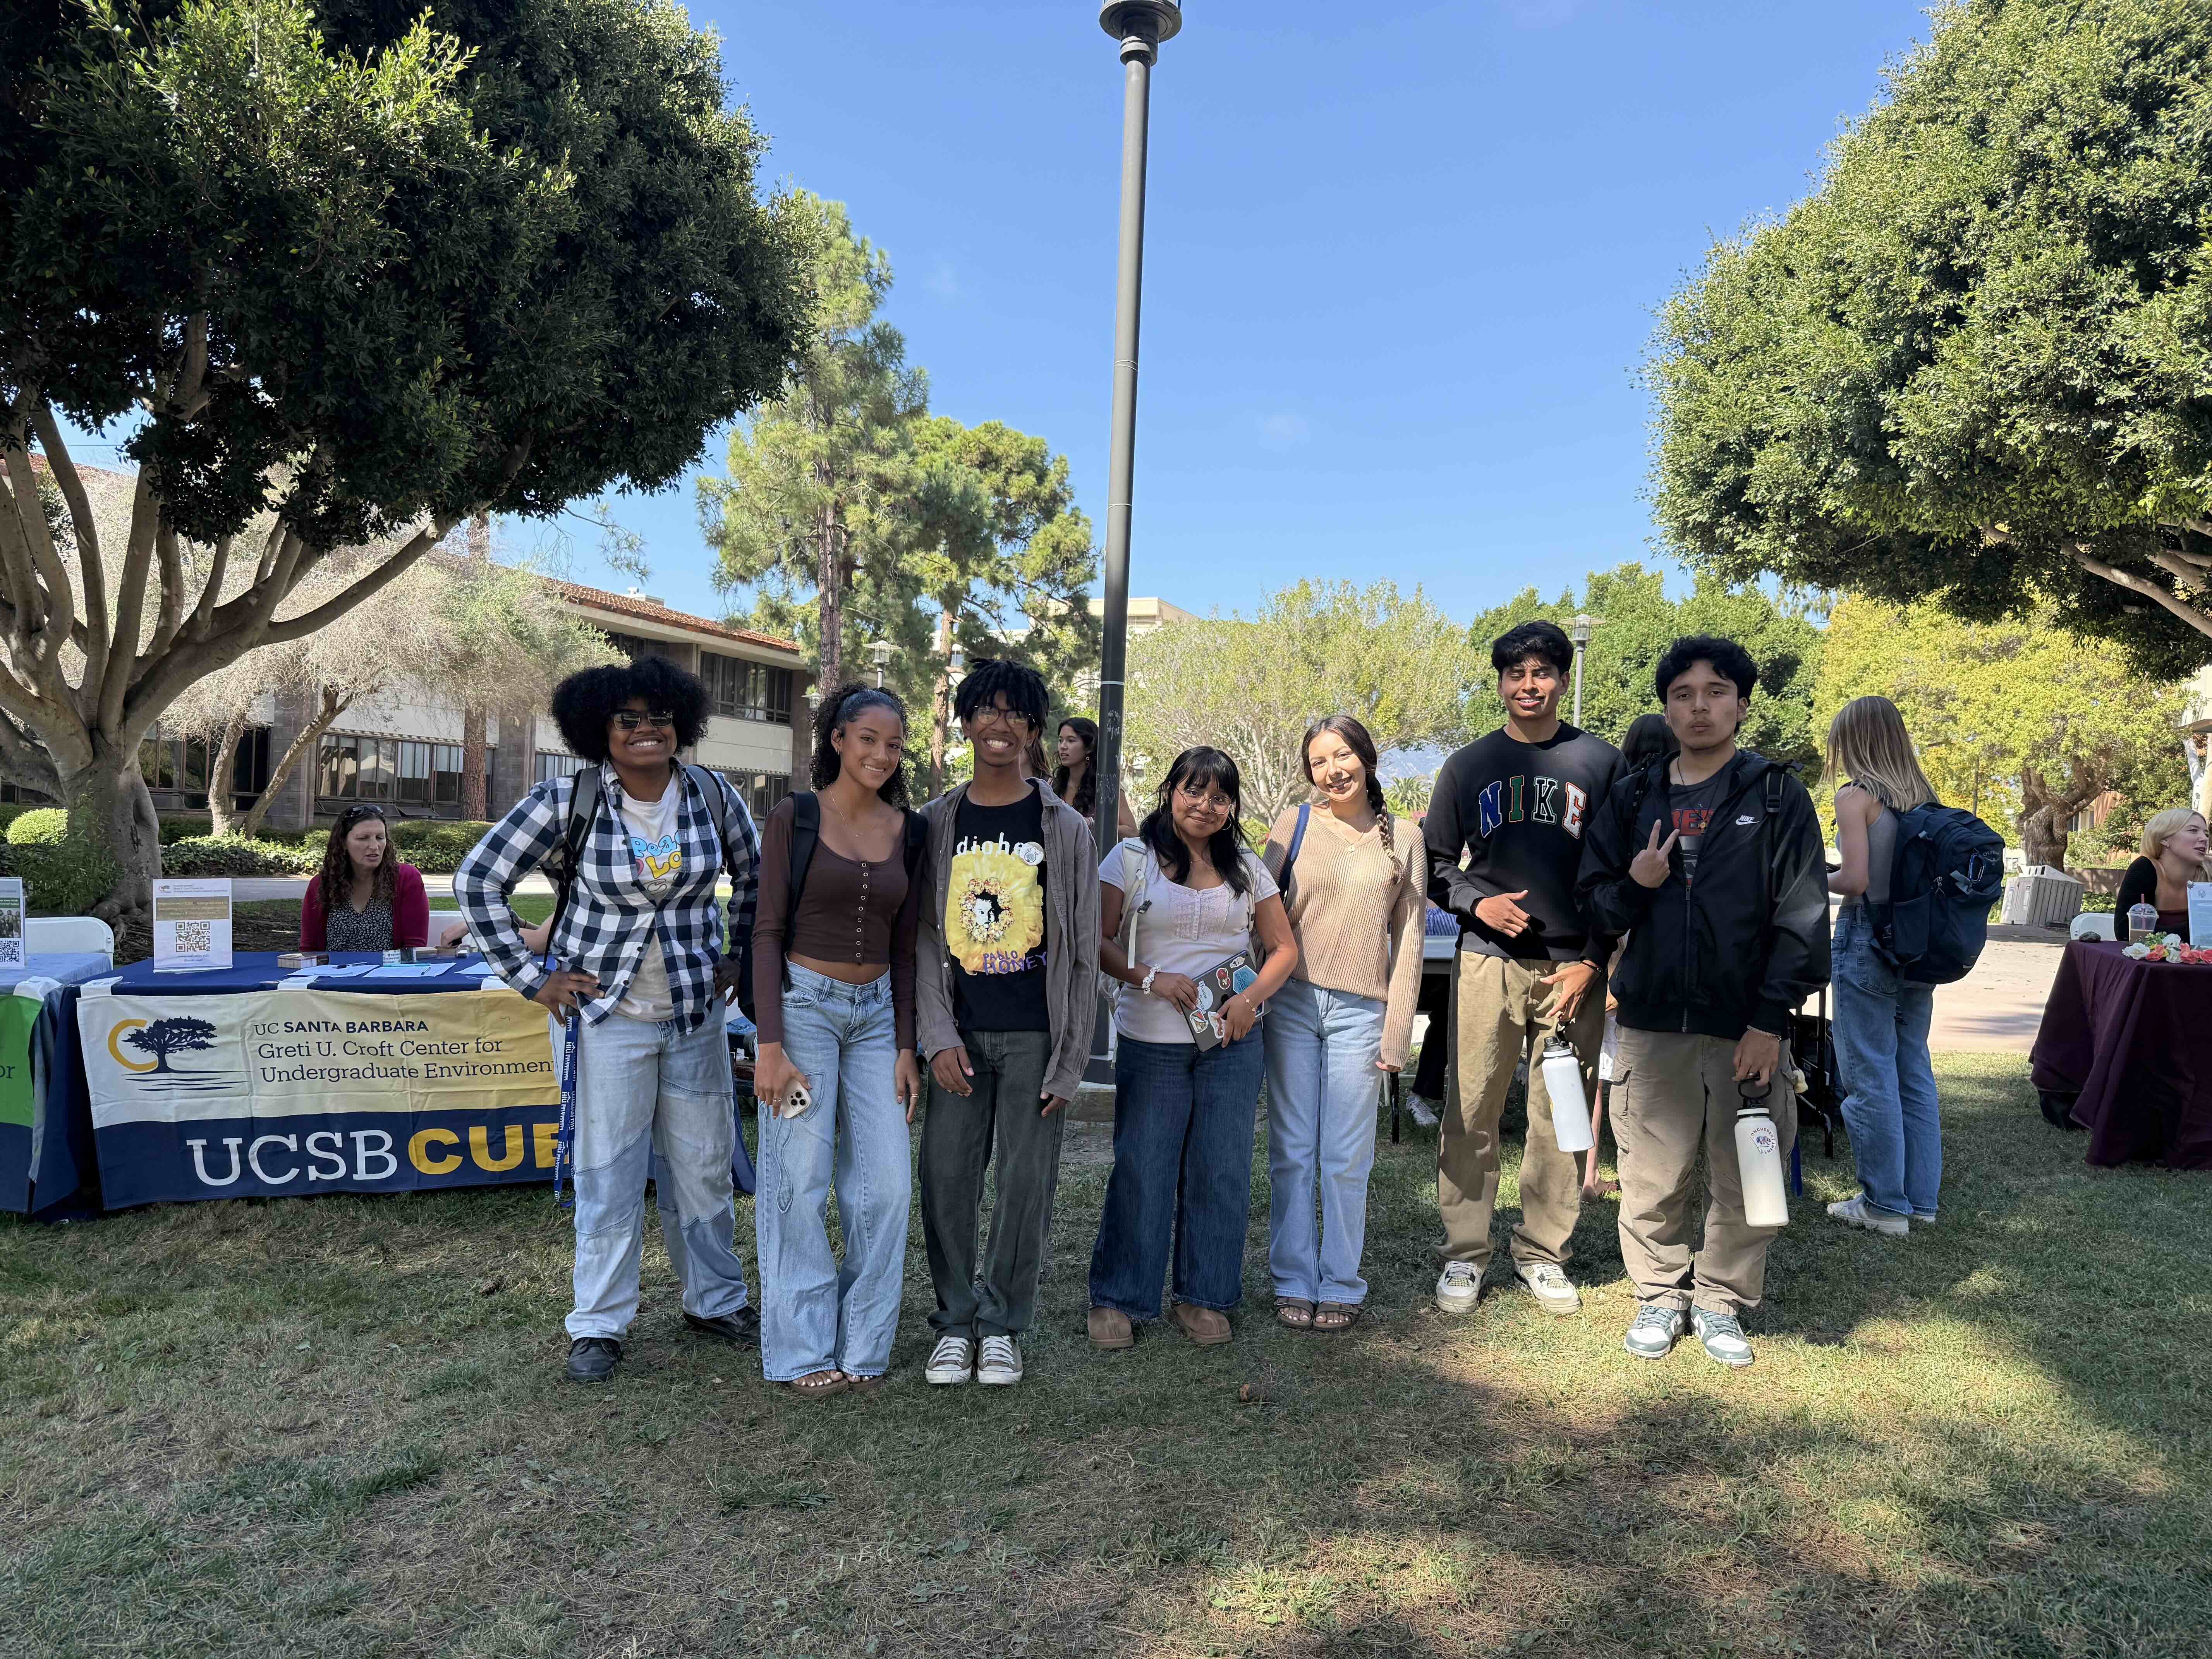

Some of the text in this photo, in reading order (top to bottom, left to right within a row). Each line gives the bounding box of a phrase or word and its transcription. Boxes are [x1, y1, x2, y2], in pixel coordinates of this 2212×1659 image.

[1479, 775, 1587, 839] NIKE
[1738, 815, 1755, 823] NIKE
[983, 950, 1018, 961] PABLO
[984, 951, 1047, 976] HONEY
[254, 1020, 429, 1036] UC SANTA BARBARA
[258, 1037, 503, 1059] Greti U. Croft Center for
[260, 1062, 419, 1083] Undergraduate
[424, 1059, 554, 1079] Environmen
[186, 1130, 398, 1186] UCSB
